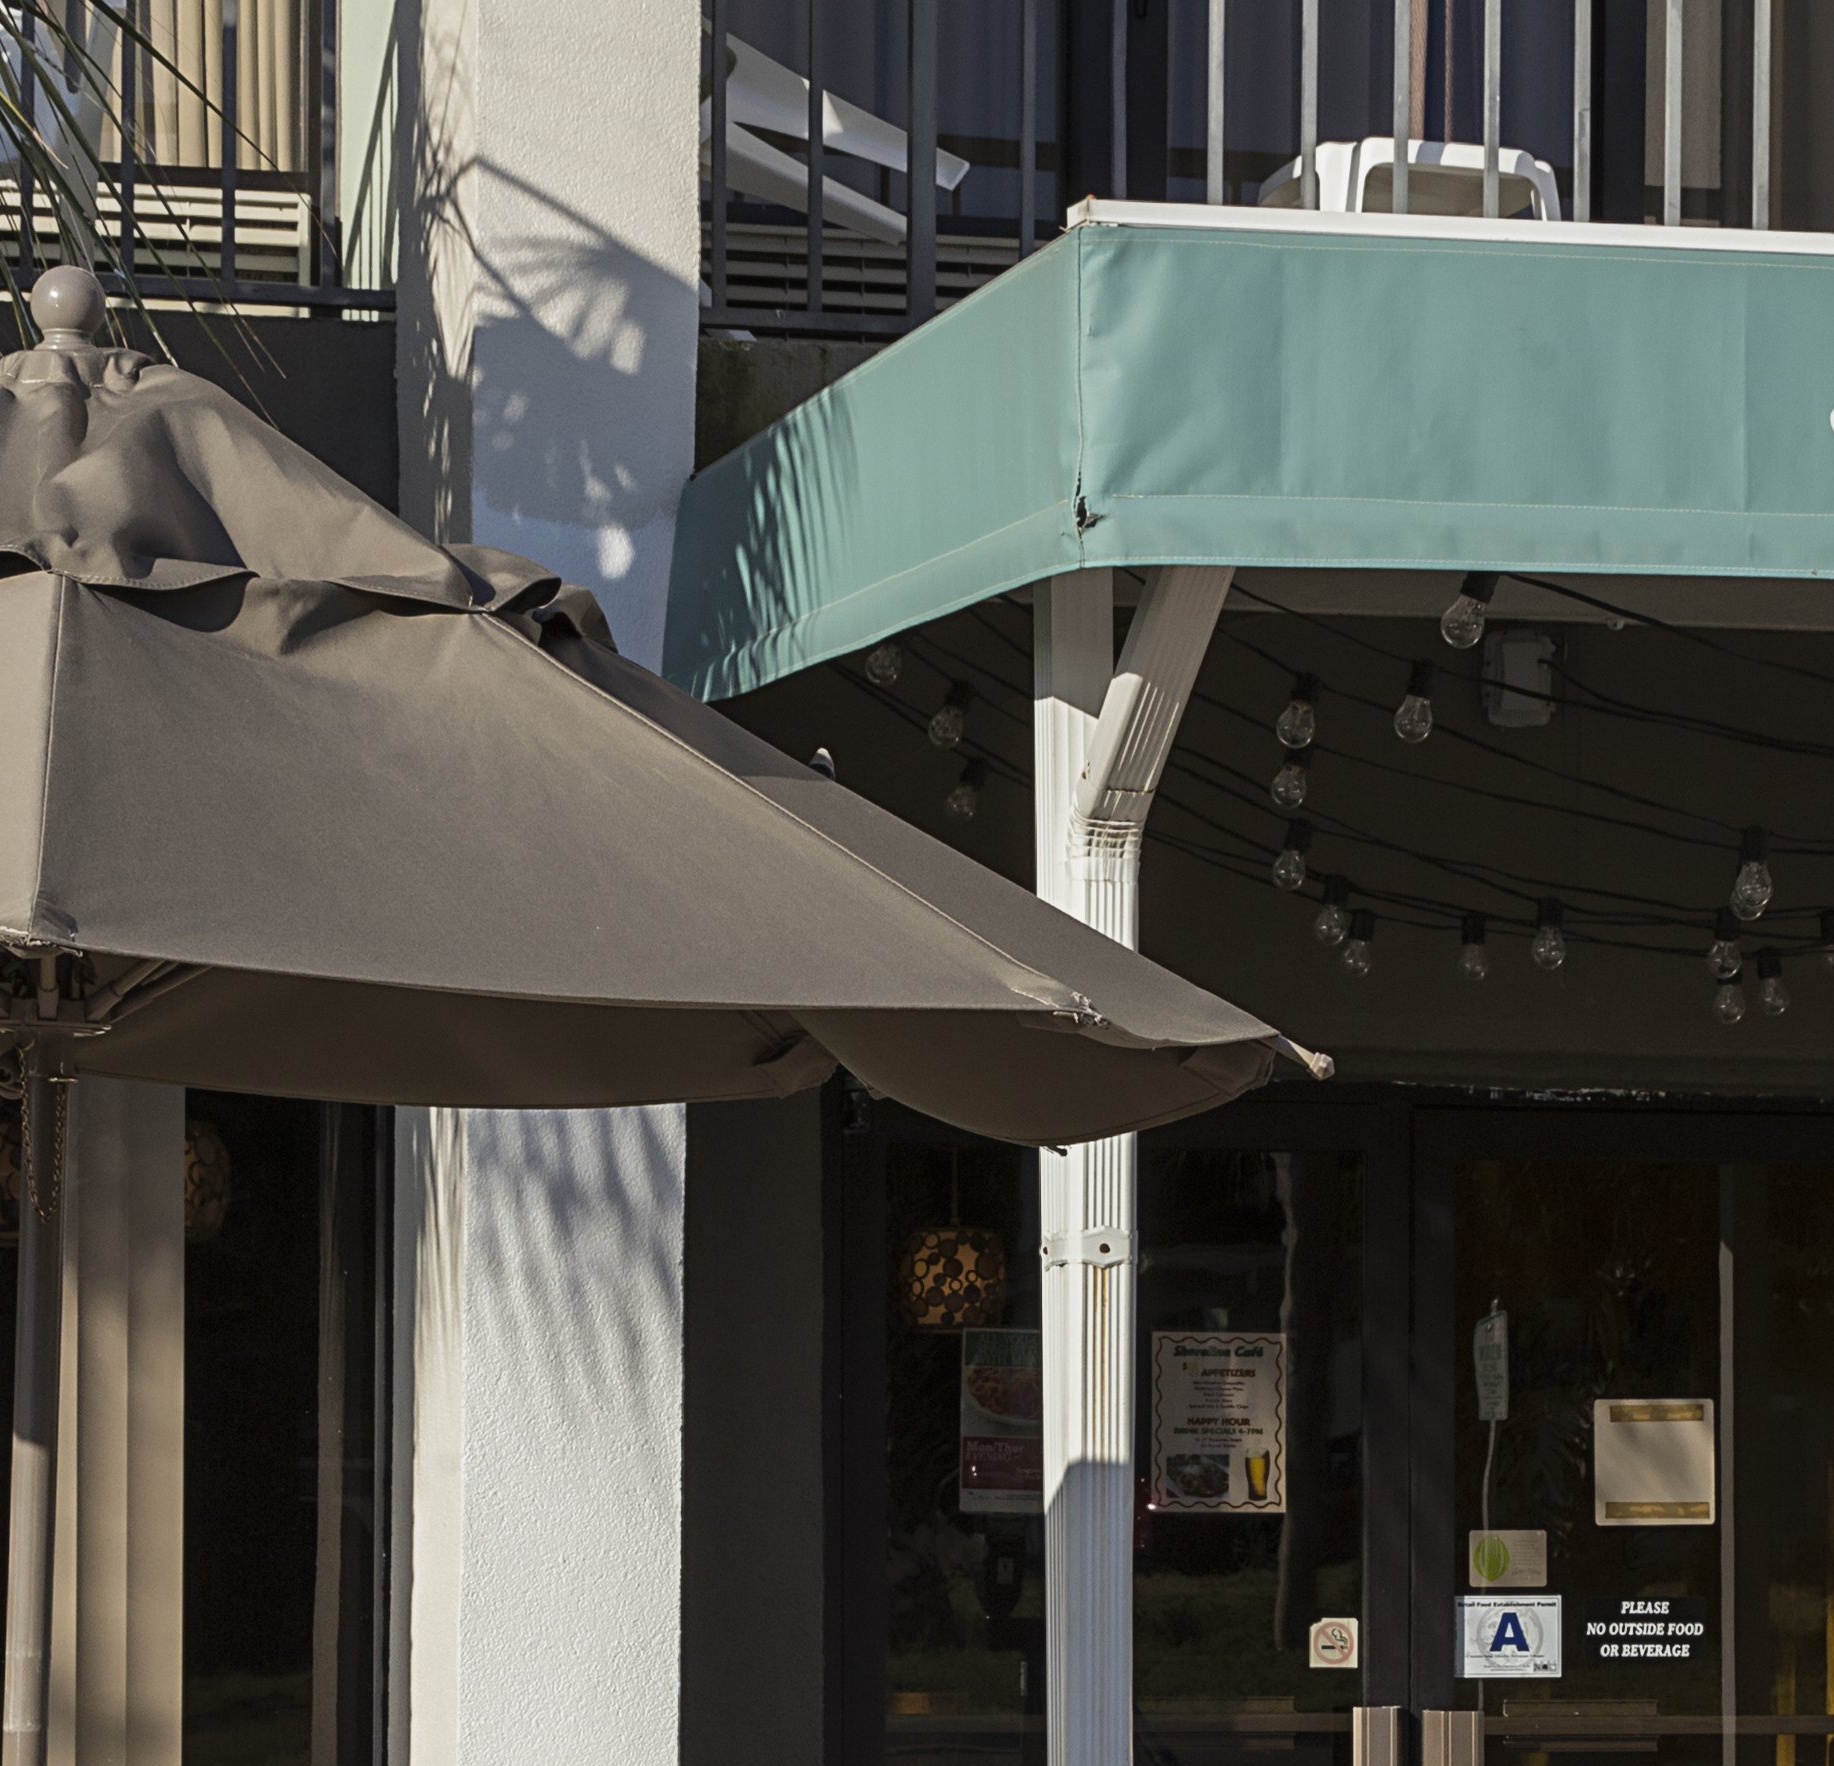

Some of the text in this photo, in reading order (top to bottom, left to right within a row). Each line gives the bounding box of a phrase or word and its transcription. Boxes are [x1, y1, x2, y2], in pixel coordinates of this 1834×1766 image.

[1201, 1369, 1256, 1378] APPETIZERS
[1187, 1418, 1251, 1426] HAPPY HOUR
[1621, 1601, 1670, 1614] PLEASE
[1489, 1611, 1530, 1653] A
[1586, 1623, 1704, 1636] NO OUTSIDE FOOD
[1600, 1644, 1690, 1657] OR BEVERAGE
